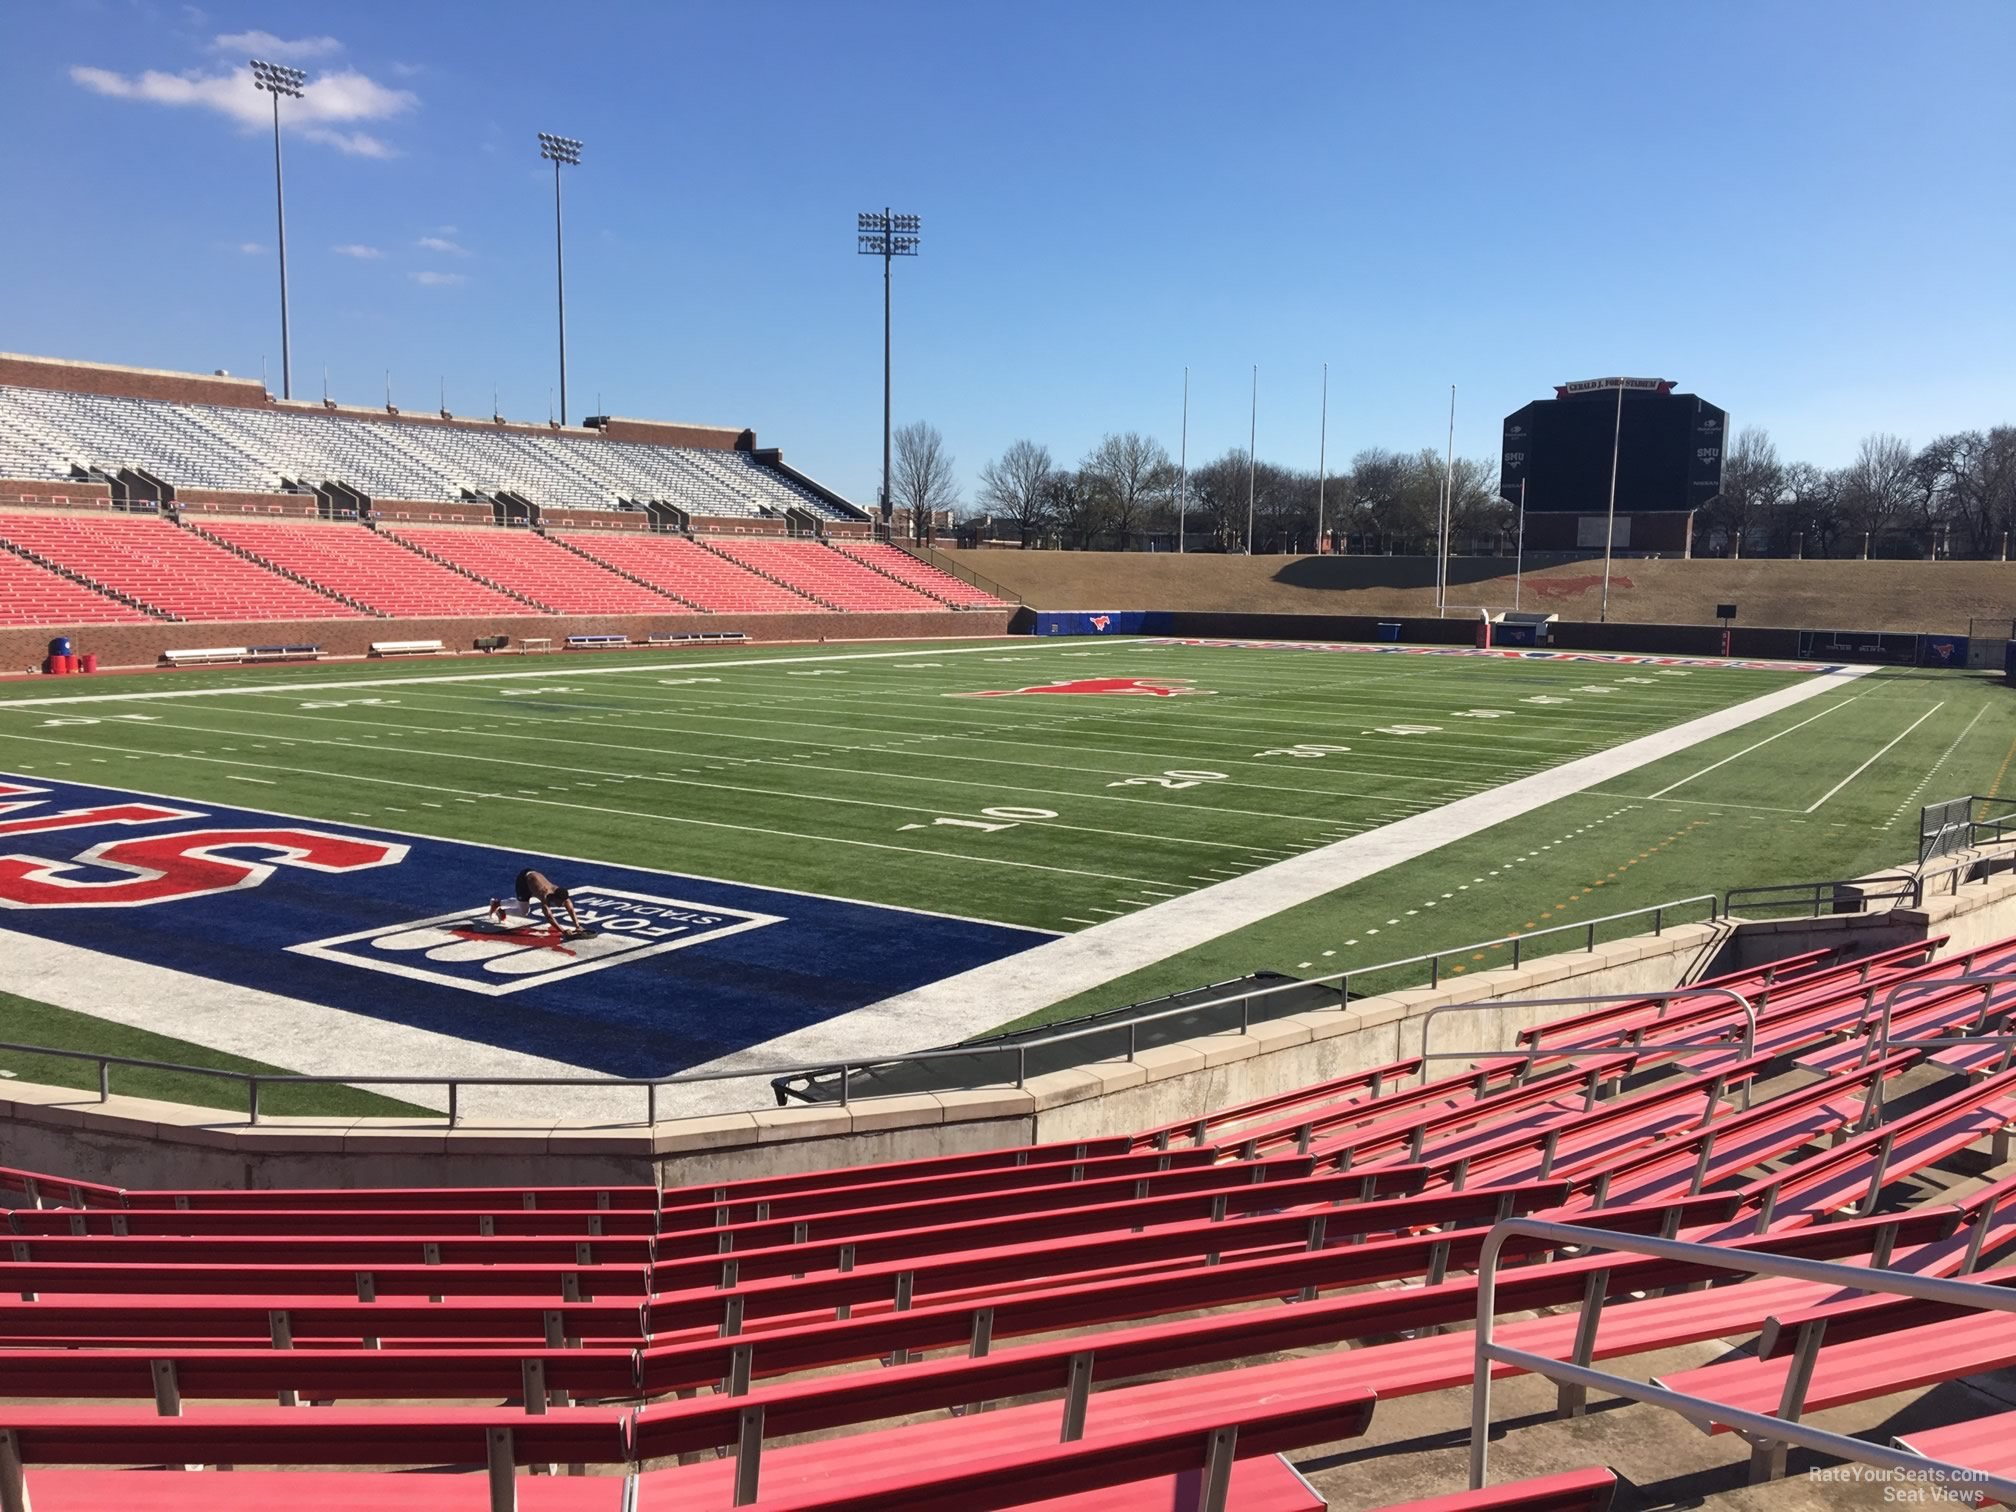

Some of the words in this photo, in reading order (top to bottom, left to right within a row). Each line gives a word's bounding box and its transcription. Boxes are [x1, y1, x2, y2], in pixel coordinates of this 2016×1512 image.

[1569, 381, 1597, 391] GERALD
[1624, 379, 1657, 388] STADIUM
[1505, 452, 1524, 462] SMU
[1697, 448, 1719, 457] SMU
[1124, 770, 1229, 789] 20
[932, 806, 1059, 832] 10
[576, 897, 722, 925] STADIUM
